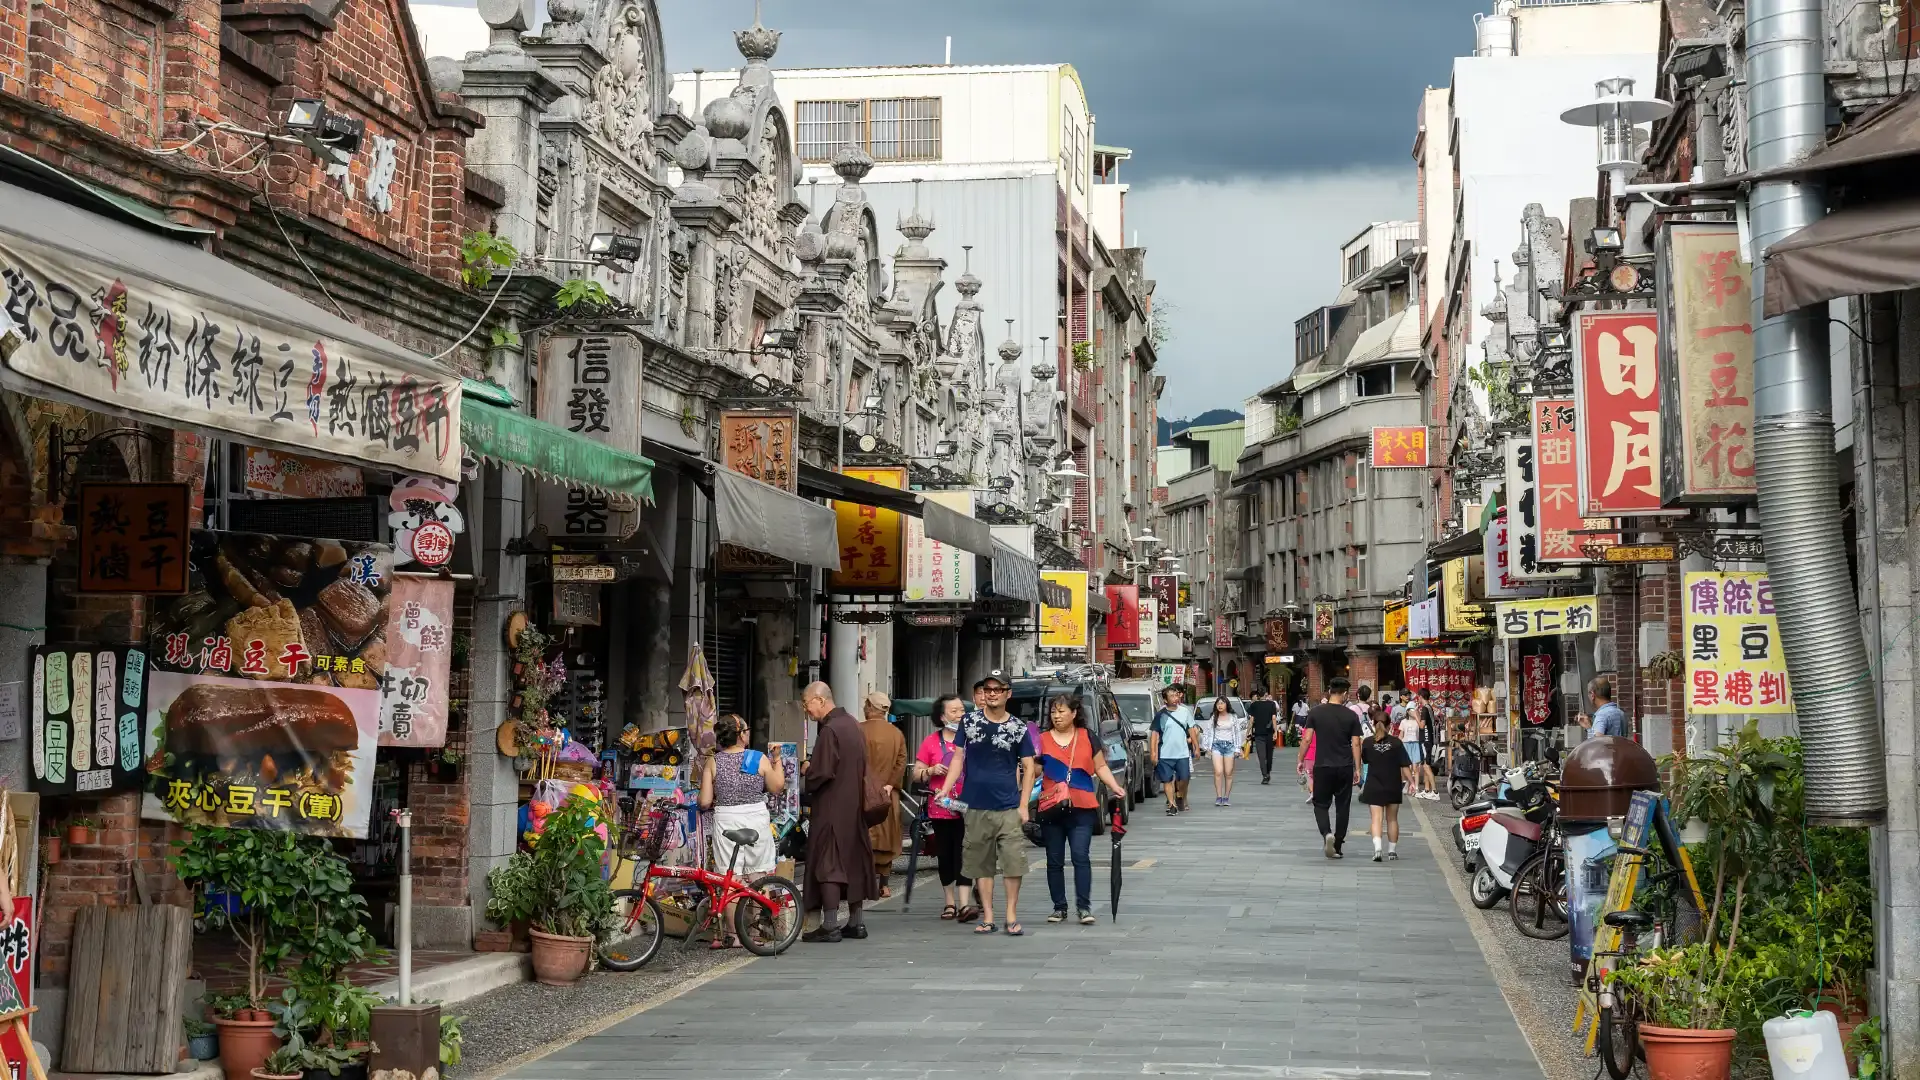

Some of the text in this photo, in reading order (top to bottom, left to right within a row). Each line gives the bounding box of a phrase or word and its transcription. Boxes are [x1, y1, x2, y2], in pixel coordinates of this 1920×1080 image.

[1697, 250, 1754, 478] 第一豆花
[1541, 406, 1553, 434] 大溪
[1376, 430, 1425, 450] 黃大目
[1541, 438, 1576, 556] 甜不辣
[138, 501, 178, 587] 豆干
[1503, 604, 1593, 635] 杏仁粉
[165, 633, 311, 675] 現滷豆干
[1693, 624, 1769, 661] 黑豆
[317, 655, 366, 674] 可素食
[1693, 670, 1786, 706] 黑糖剉
[166, 780, 343, 820] 夾心豆干(葷)
